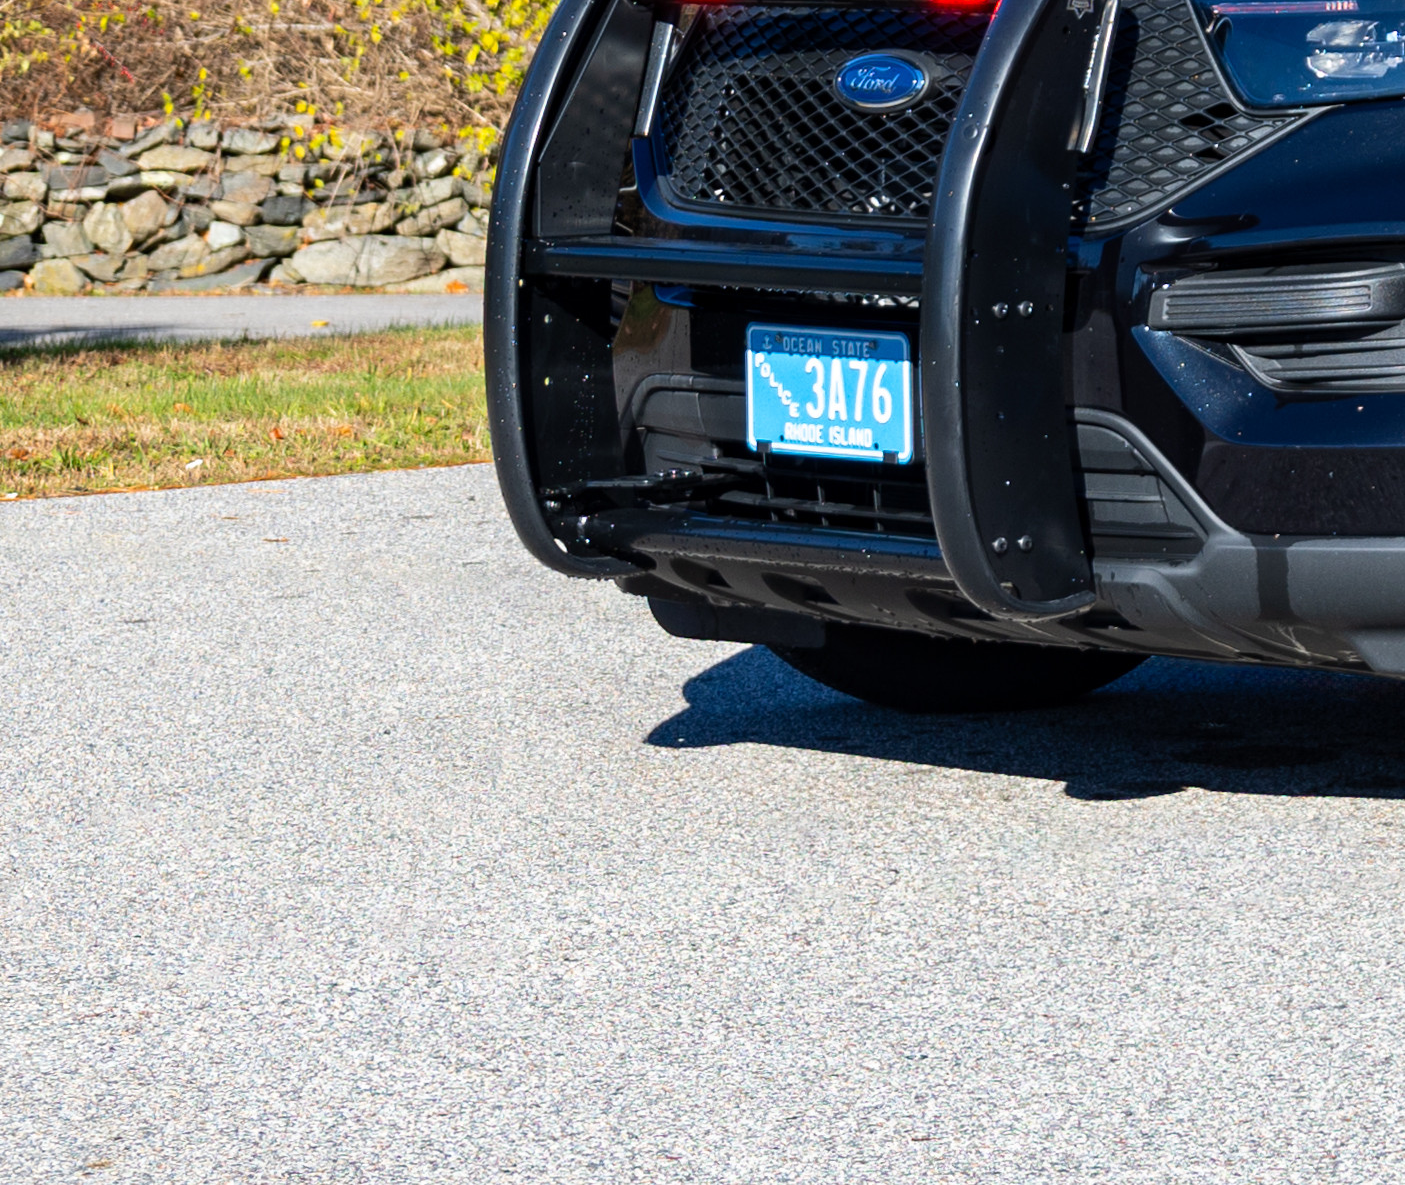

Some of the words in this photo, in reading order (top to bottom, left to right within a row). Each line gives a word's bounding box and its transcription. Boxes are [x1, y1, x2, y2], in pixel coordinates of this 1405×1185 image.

[850, 66, 900, 94] Ford
[782, 335, 822, 353] OCEAN
[832, 339, 870, 358] STATE
[755, 352, 800, 418] POLICE
[805, 357, 893, 424] 3A76
[784, 422, 824, 444] RHODE
[828, 425, 873, 448] ISLAND
